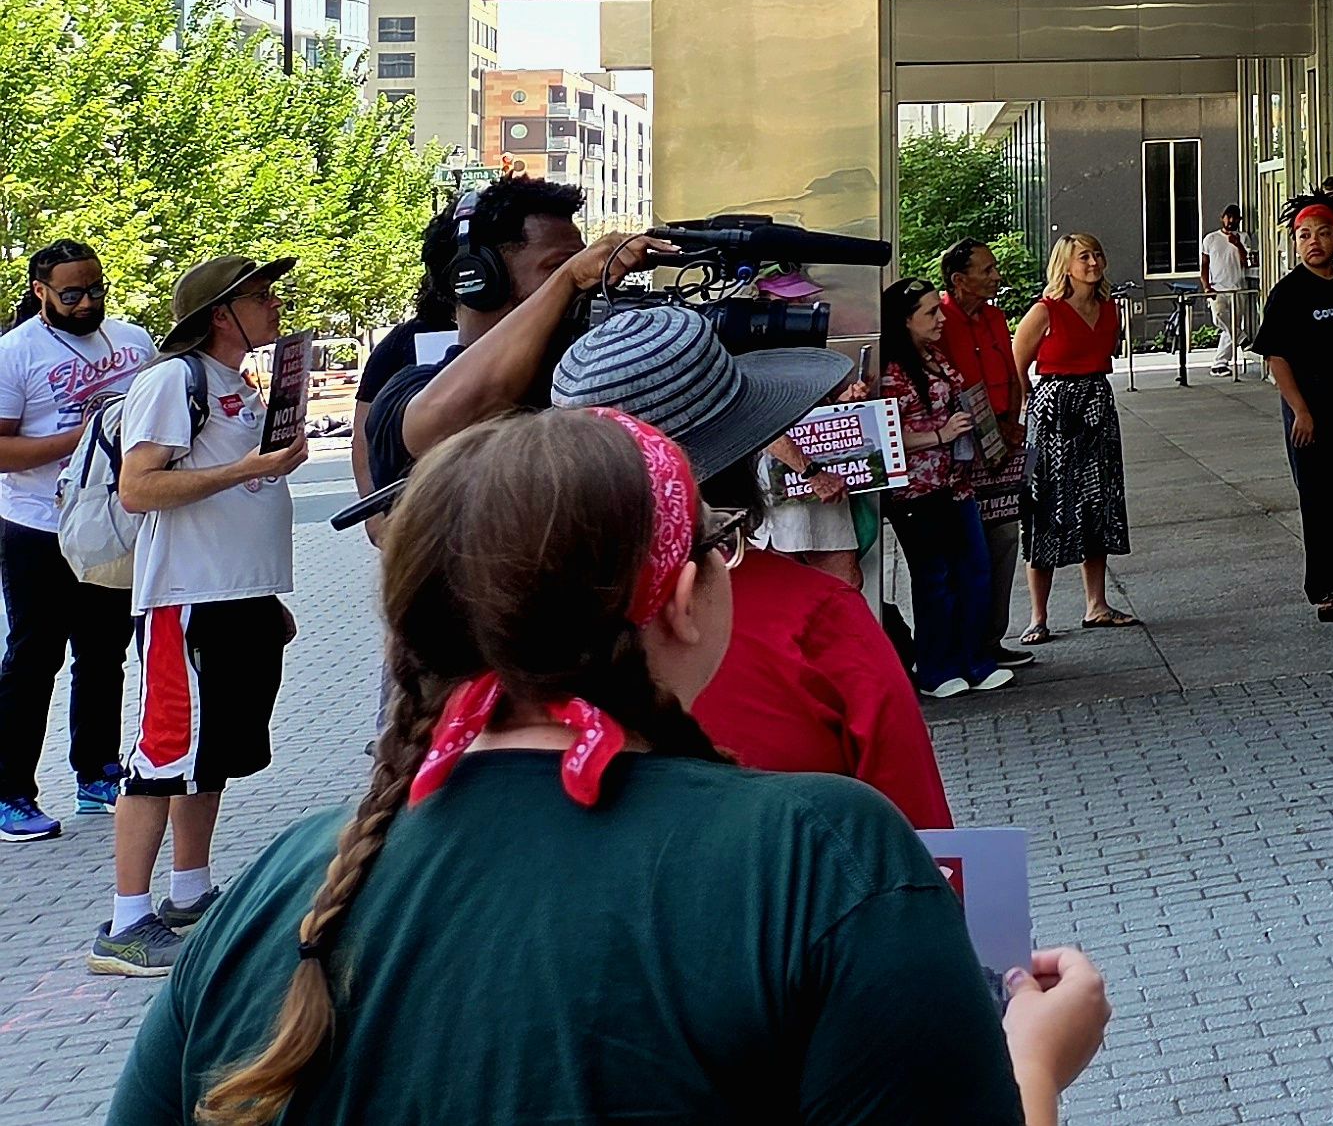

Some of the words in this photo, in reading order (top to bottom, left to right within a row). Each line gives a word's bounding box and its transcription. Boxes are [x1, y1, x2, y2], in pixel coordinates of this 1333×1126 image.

[786, 424, 811, 438] NDY
[814, 416, 859, 433] NEEDS
[819, 428, 860, 442] CENTER
[802, 437, 862, 455] RATORIUM
